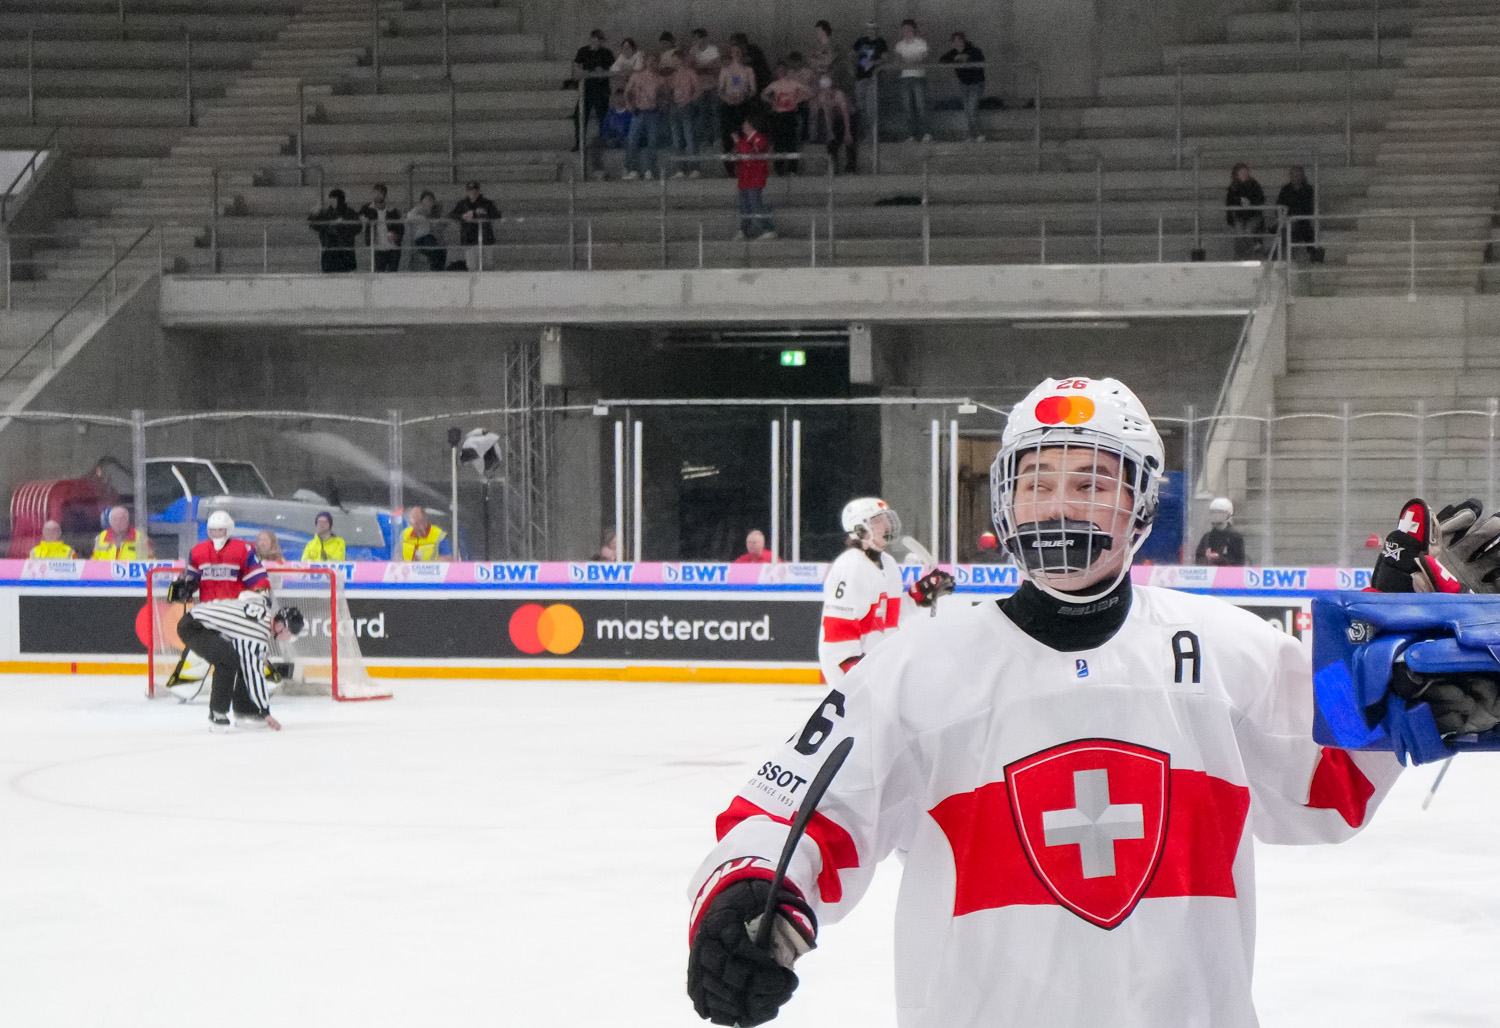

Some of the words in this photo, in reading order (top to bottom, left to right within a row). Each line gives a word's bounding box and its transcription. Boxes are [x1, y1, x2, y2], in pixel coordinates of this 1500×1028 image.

[1056, 379, 1089, 390] 26
[493, 564, 539, 581] BWT
[587, 565, 633, 581] BWT
[681, 565, 729, 582] BWT
[1262, 569, 1307, 588] BWT
[835, 581, 847, 599] 6
[1171, 630, 1201, 684] A
[757, 781, 777, 797] SINCE
[777, 793, 794, 807] 1853
